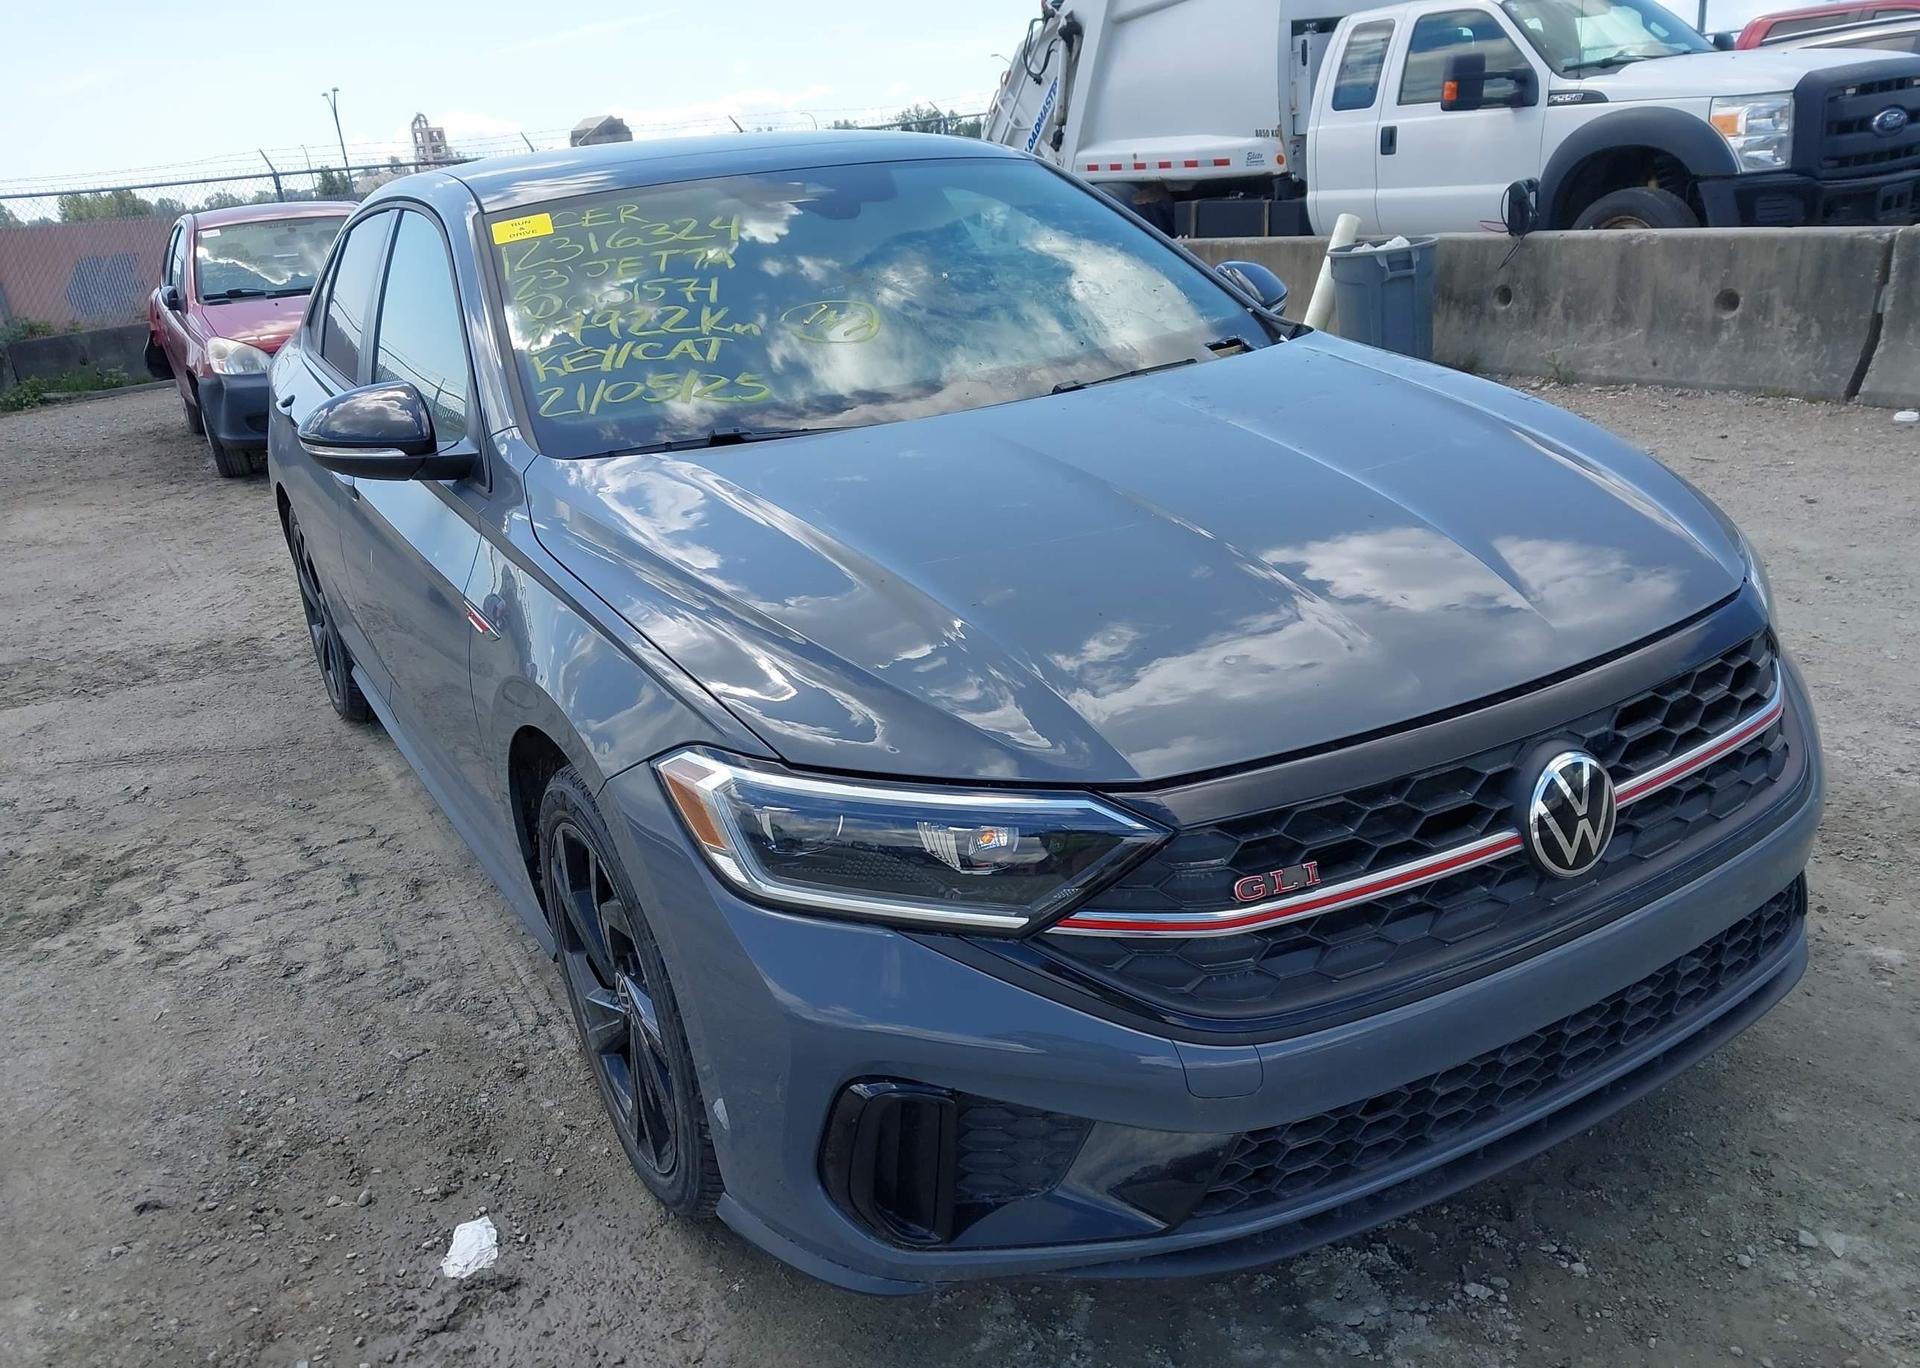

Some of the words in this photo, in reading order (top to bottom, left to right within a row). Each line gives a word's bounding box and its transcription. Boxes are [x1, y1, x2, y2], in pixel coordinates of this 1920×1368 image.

[1024, 76, 1058, 153] LOADMASTE
[509, 229, 538, 239] DRIVE
[511, 219, 532, 228] RUN
[580, 246, 737, 279] JETTA
[537, 369, 772, 418] 21/05/25
[1233, 860, 1322, 904] GLI
